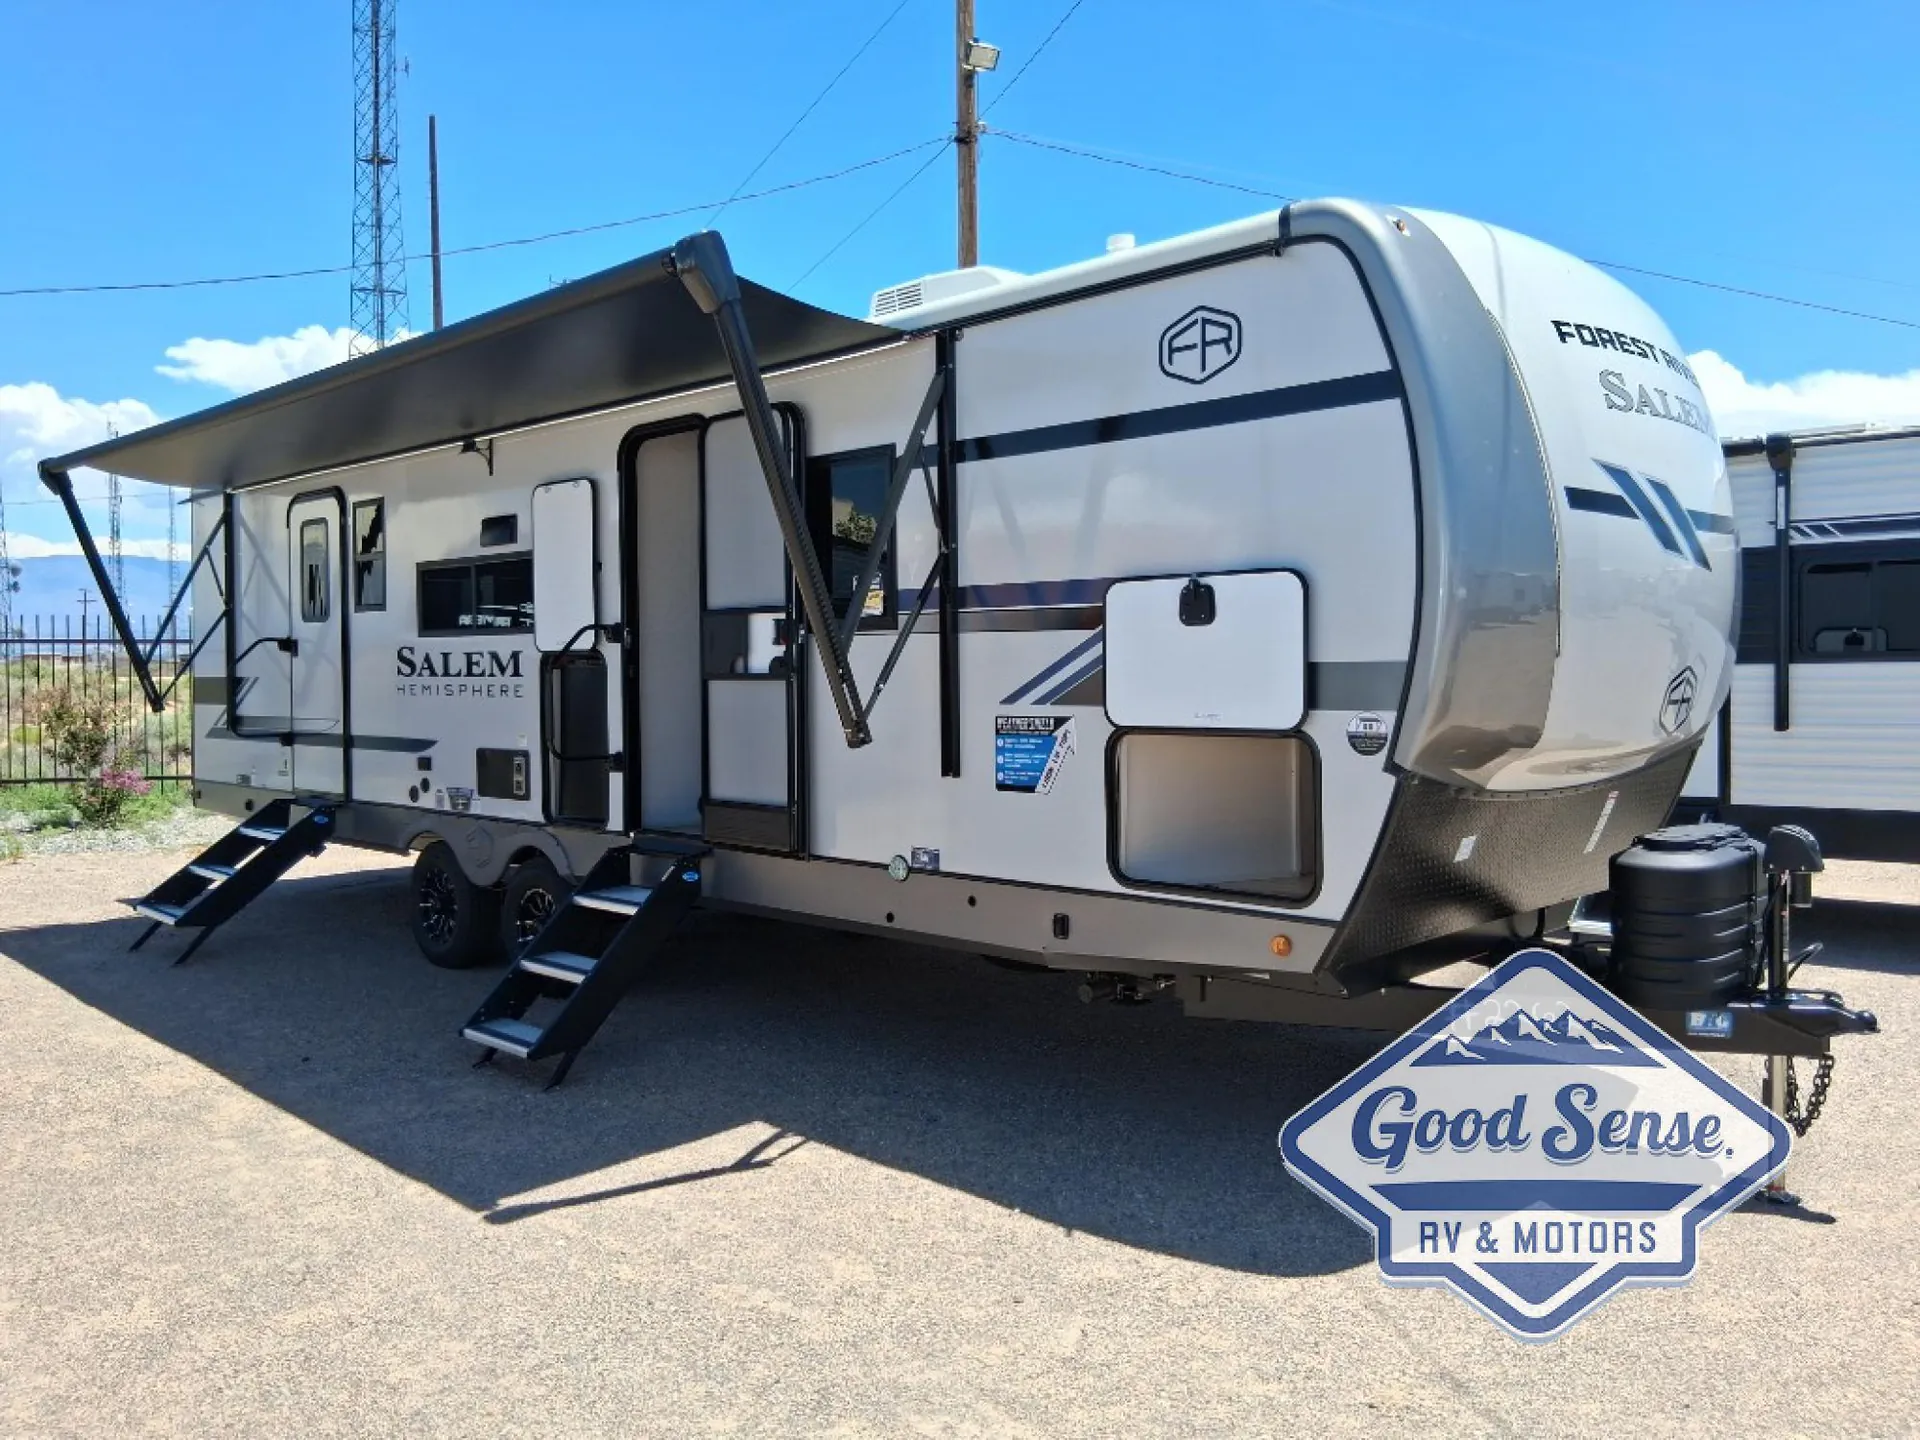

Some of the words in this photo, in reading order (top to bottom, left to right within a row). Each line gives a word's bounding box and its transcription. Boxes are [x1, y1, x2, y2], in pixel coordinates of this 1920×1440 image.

[1551, 320, 1659, 363] FOREST
[397, 646, 524, 678] SALEM
[397, 683, 524, 698] HEMISPHERE
